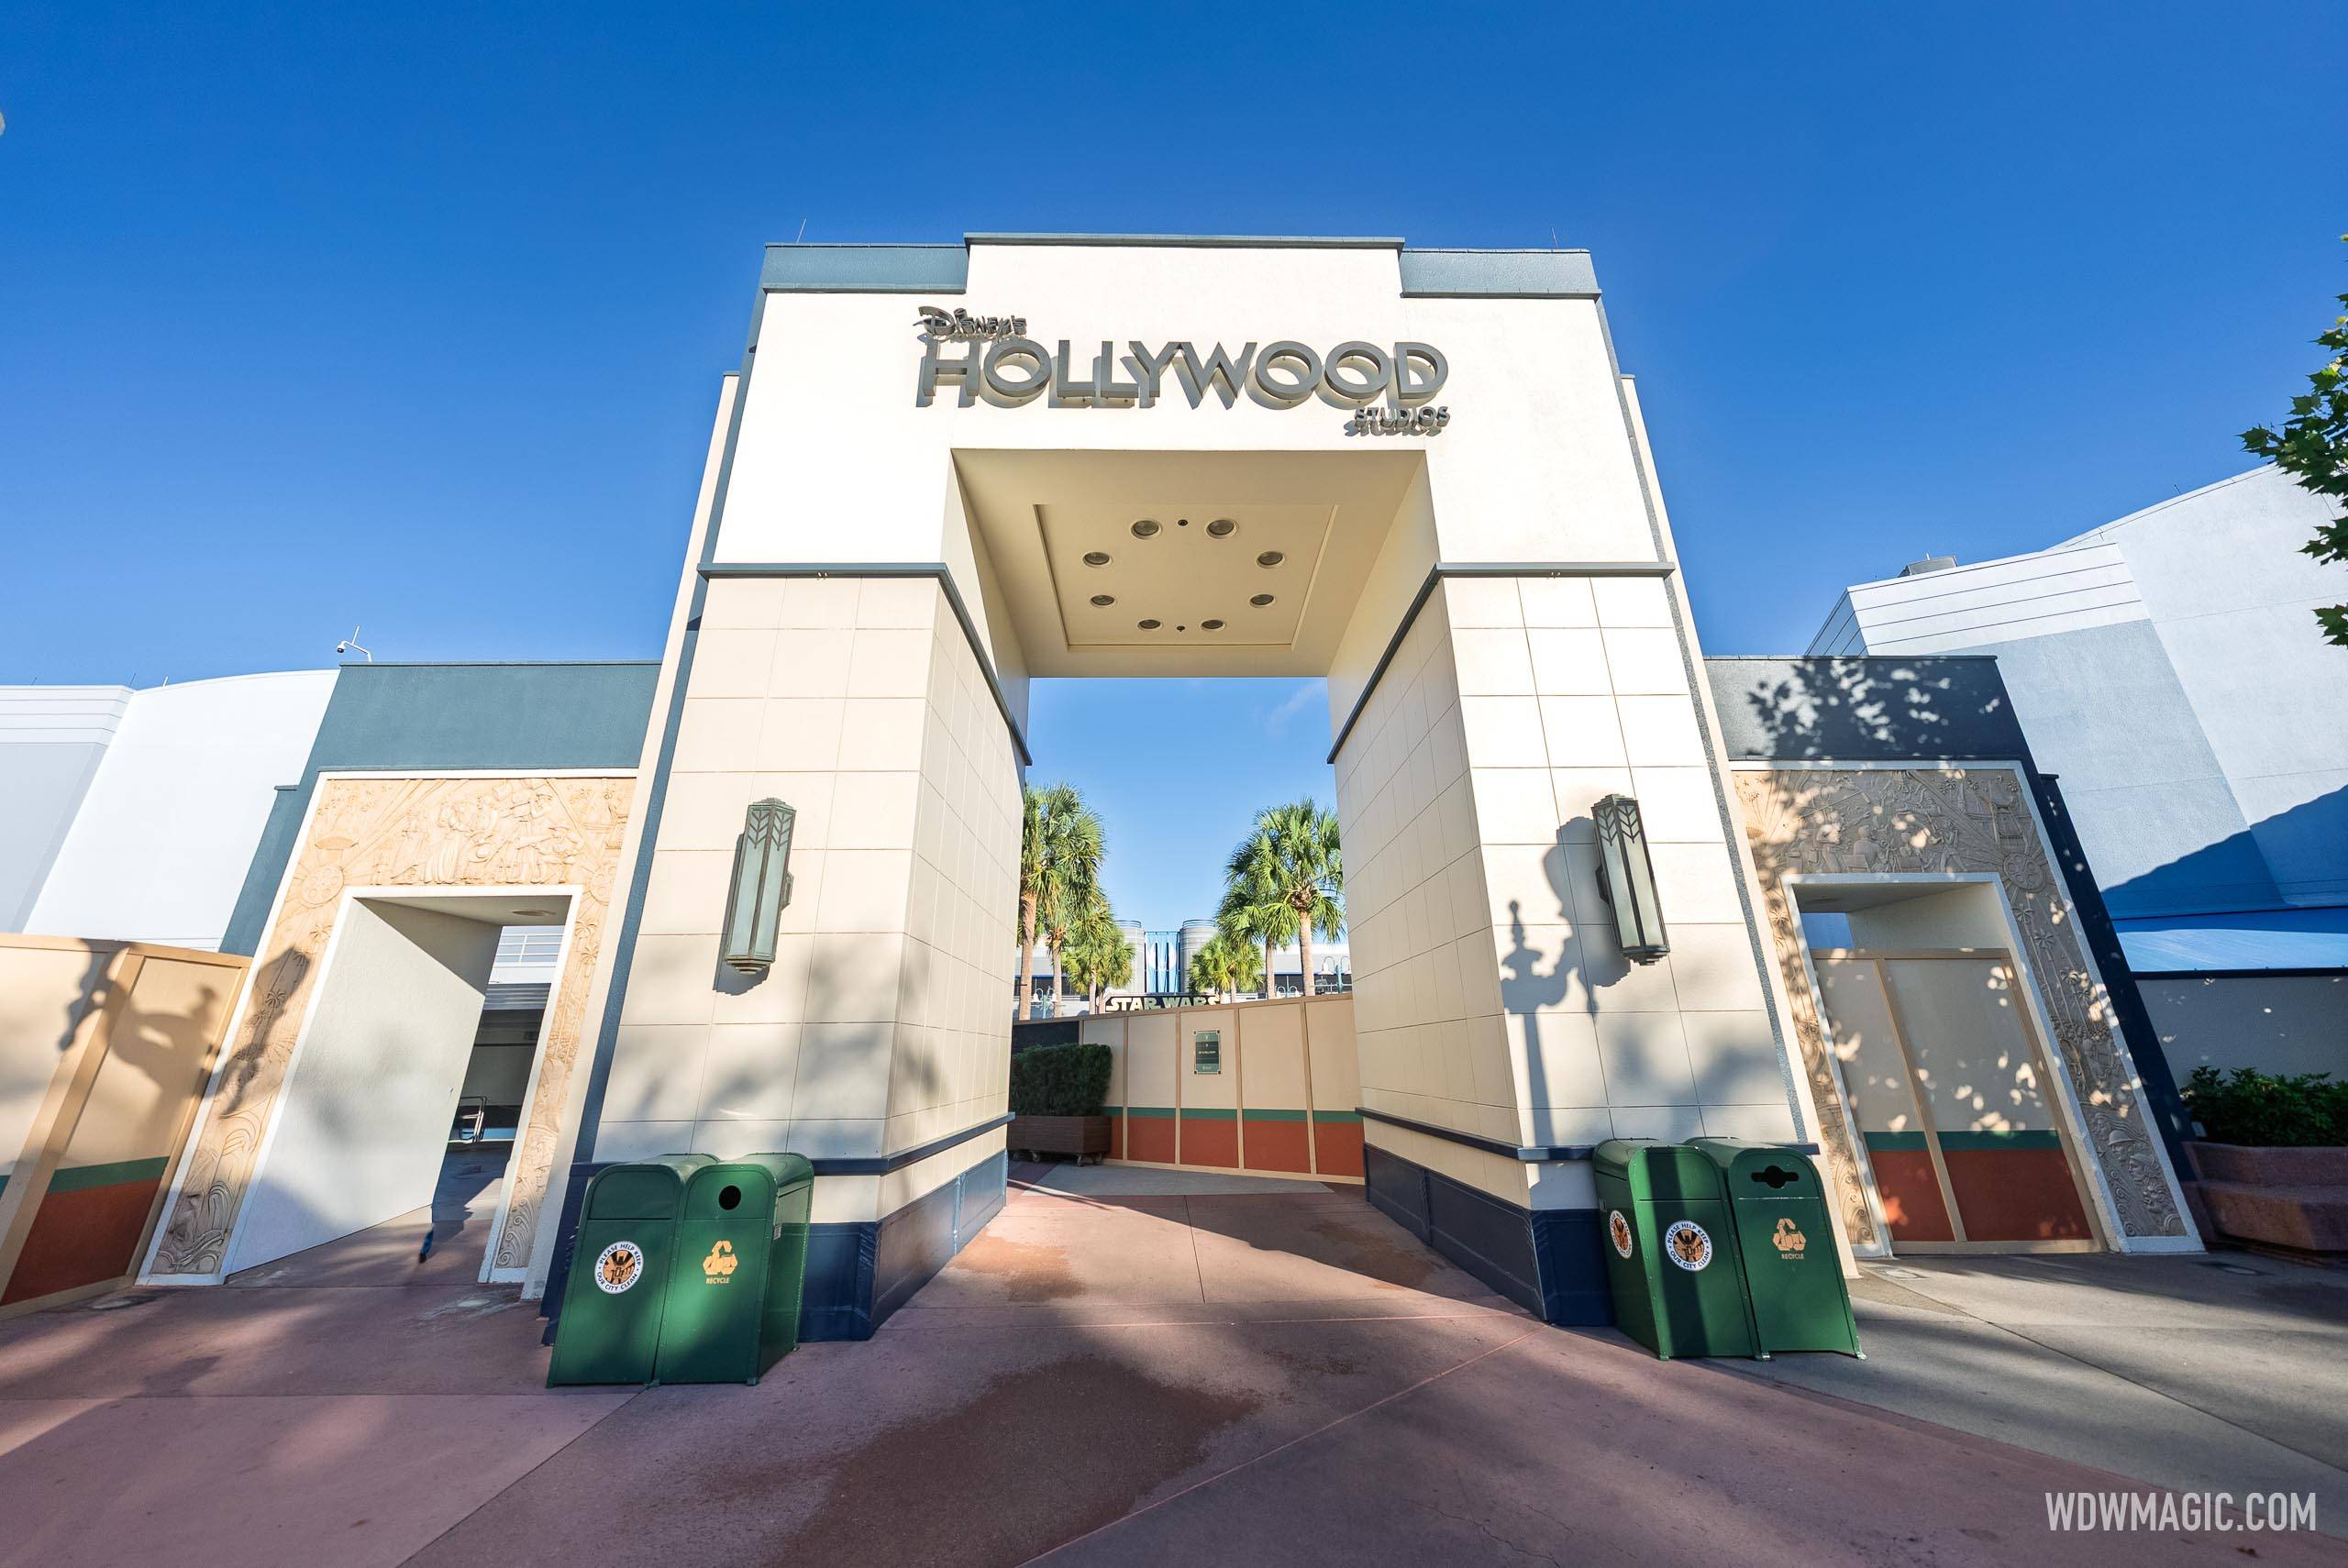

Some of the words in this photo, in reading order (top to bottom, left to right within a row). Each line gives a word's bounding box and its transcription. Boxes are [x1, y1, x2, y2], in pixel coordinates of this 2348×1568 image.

[922, 338, 1449, 400] HOLLYWOOD
[1355, 405, 1451, 428] STUDIOS
[1106, 996, 1161, 1011] STAR
[1162, 996, 1221, 1009] WARS
[1667, 1224, 1680, 1243] PLEASE
[1697, 1229, 1710, 1243] KEEP
[599, 1244, 618, 1264] PLEASE
[634, 1251, 642, 1265] KEEP
[1670, 1251, 1682, 1264] OUR
[1698, 1251, 1711, 1267] CLEAN
[597, 1271, 605, 1285] OUR
[620, 1273, 637, 1290] CLEAN
